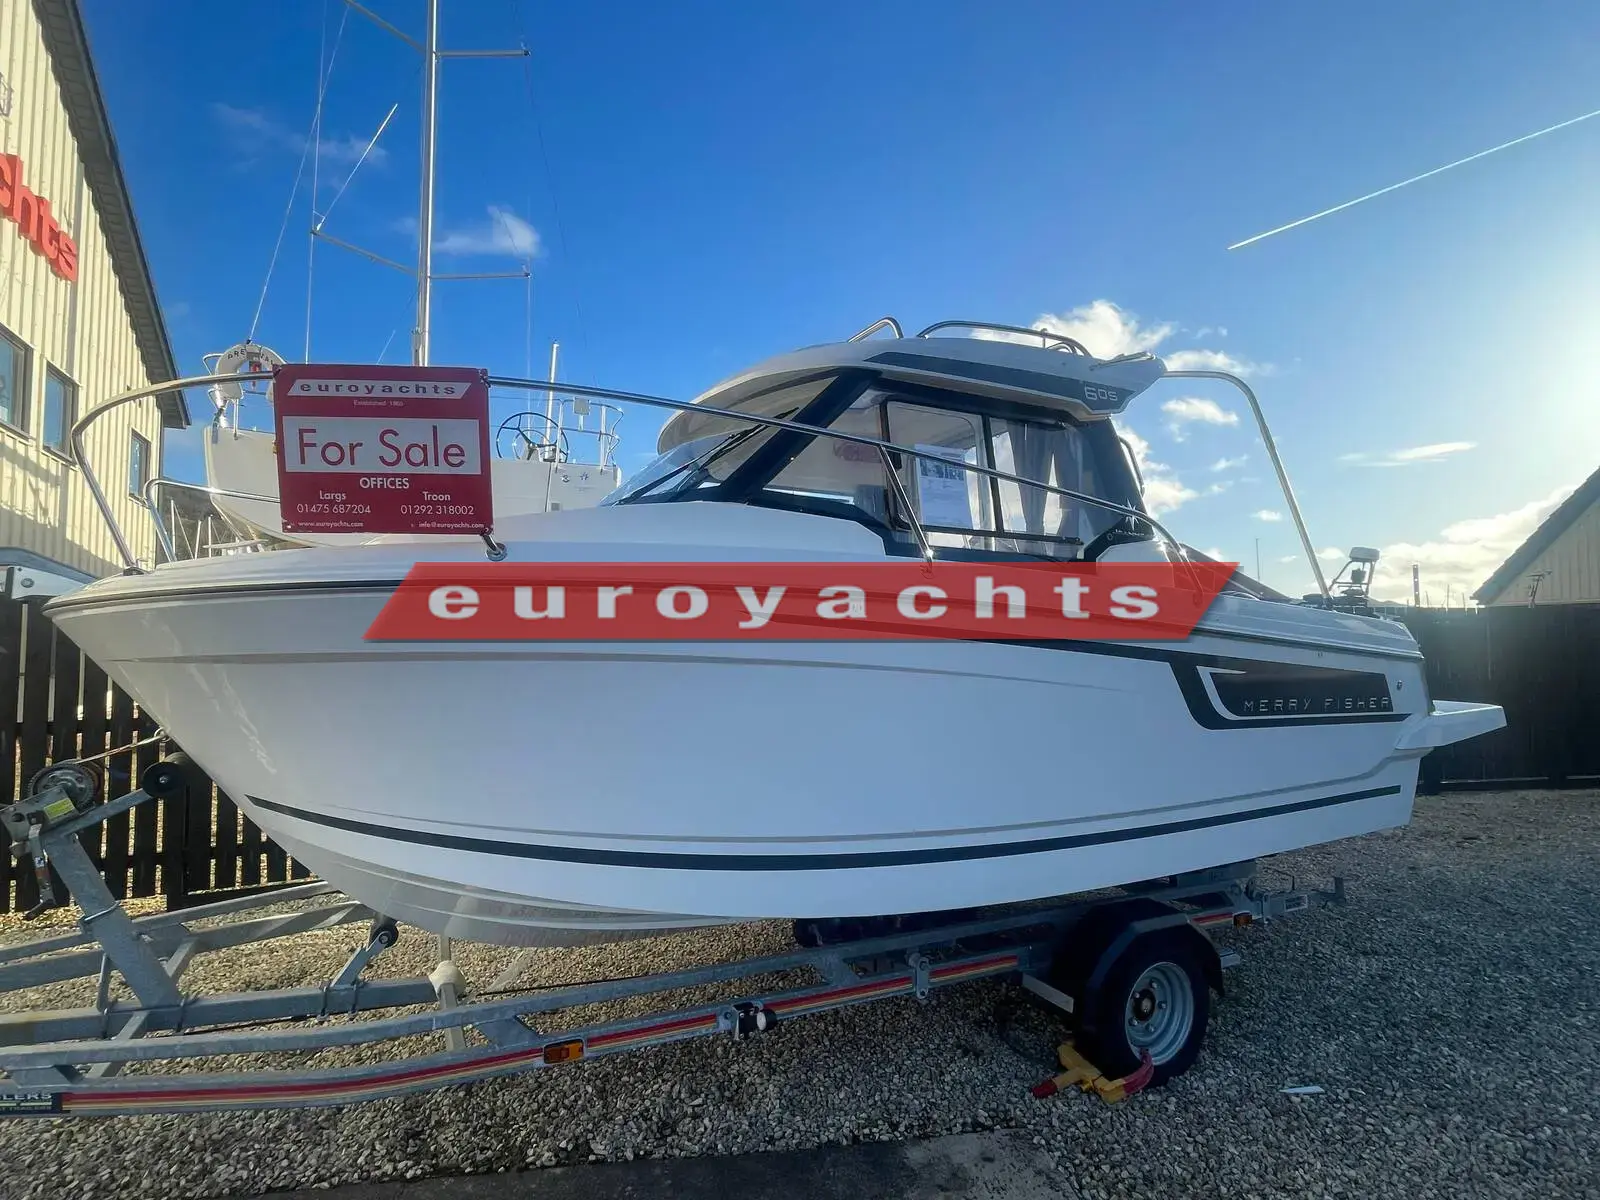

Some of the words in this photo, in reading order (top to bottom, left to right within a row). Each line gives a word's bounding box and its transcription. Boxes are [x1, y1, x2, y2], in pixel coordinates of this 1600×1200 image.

[300, 383, 455, 395] euroyachts
[298, 428, 363, 466] For
[378, 425, 466, 468] Sale
[359, 477, 410, 489] OFFICES
[319, 490, 347, 502] Largs
[422, 491, 451, 501] Troon
[296, 503, 330, 514] 01475
[332, 504, 372, 514] 687204
[400, 504, 433, 515] 01292
[435, 505, 475, 515] 318002
[298, 520, 364, 528] www.euroyachts.com
[418, 521, 484, 529] info@euroyachts.com
[1243, 698, 1313, 712] MERRY
[1324, 697, 1391, 711] FISHER
